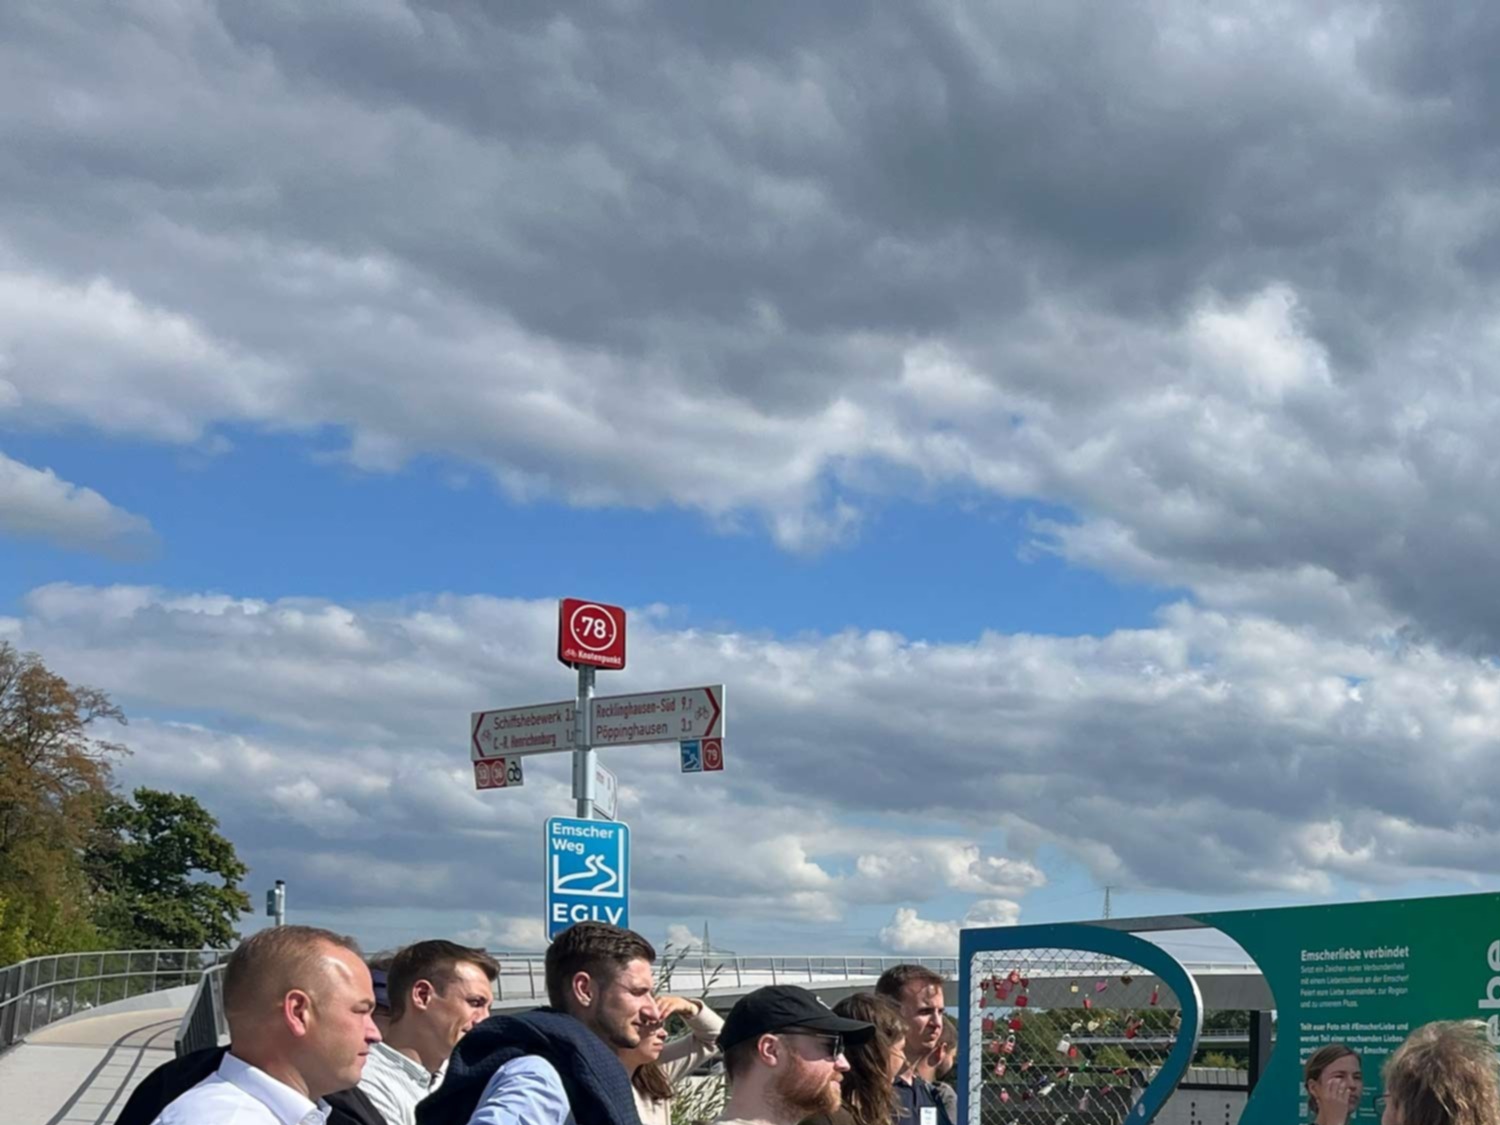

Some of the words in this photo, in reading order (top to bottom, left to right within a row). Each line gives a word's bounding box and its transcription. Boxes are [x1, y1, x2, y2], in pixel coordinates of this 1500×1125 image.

[581, 616, 606, 639] 78
[578, 650, 621, 664] Knotenpunkt
[596, 697, 676, 719] Recklinghausen-Süd
[493, 710, 562, 730] Schiffshebewerk
[596, 722, 668, 741] Pöppinghausen
[552, 822, 614, 839] Emscher
[552, 838, 585, 855] Weg
[553, 903, 624, 926] EGLV
[1301, 948, 1361, 961] Emscherliebe
[1363, 945, 1409, 959] verbindet
